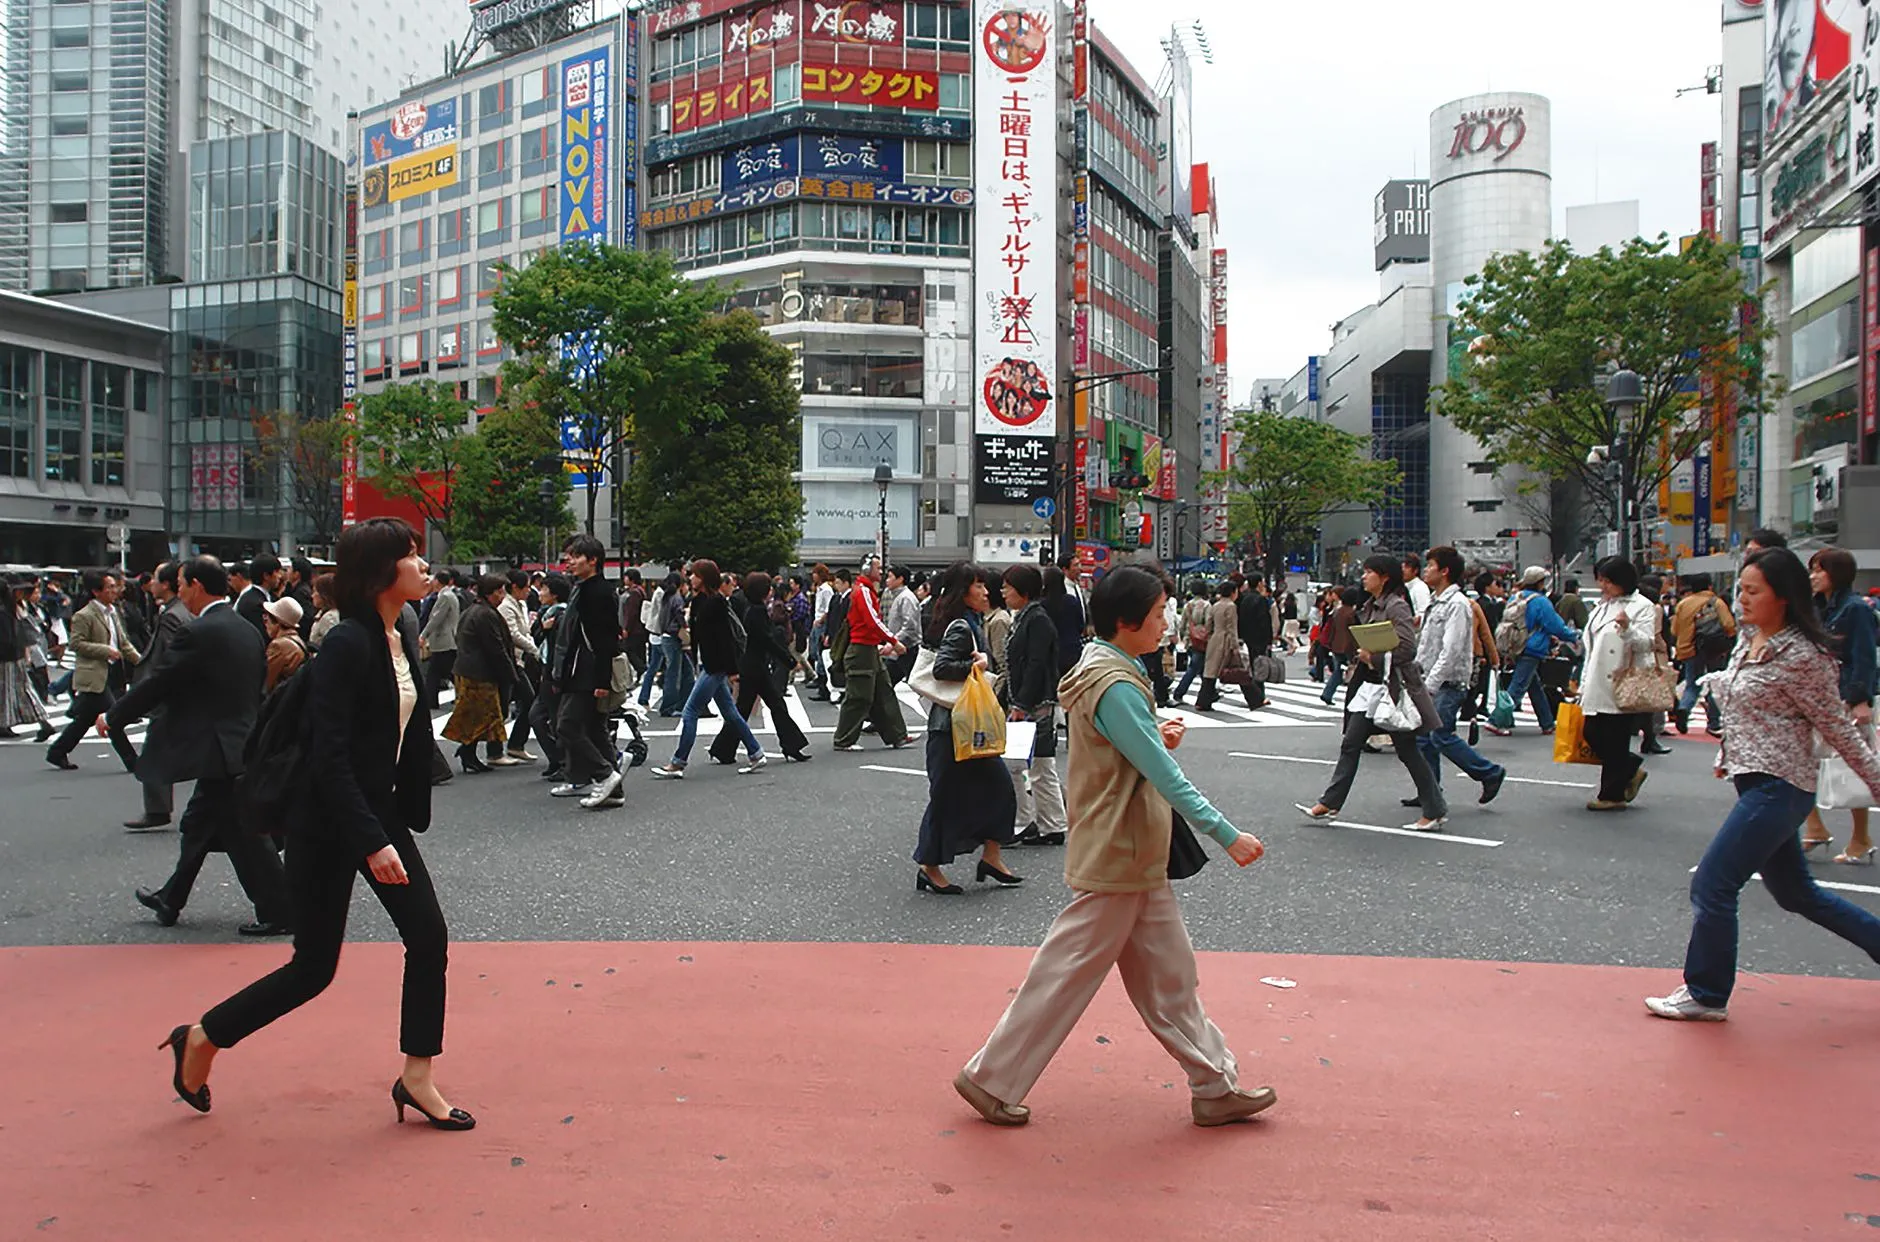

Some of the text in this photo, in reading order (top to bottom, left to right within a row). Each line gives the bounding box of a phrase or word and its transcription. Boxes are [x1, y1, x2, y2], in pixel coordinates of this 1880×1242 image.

[803, 67, 934, 100] コンタクト
[675, 76, 770, 124] プライス
[1460, 107, 1524, 121] SHIBUYA
[1447, 115, 1527, 162] 109
[437, 157, 451, 173] 4F
[564, 108, 590, 235] NOVA
[952, 191, 971, 203] 6F
[984, 438, 1048, 460] ギャルサー
